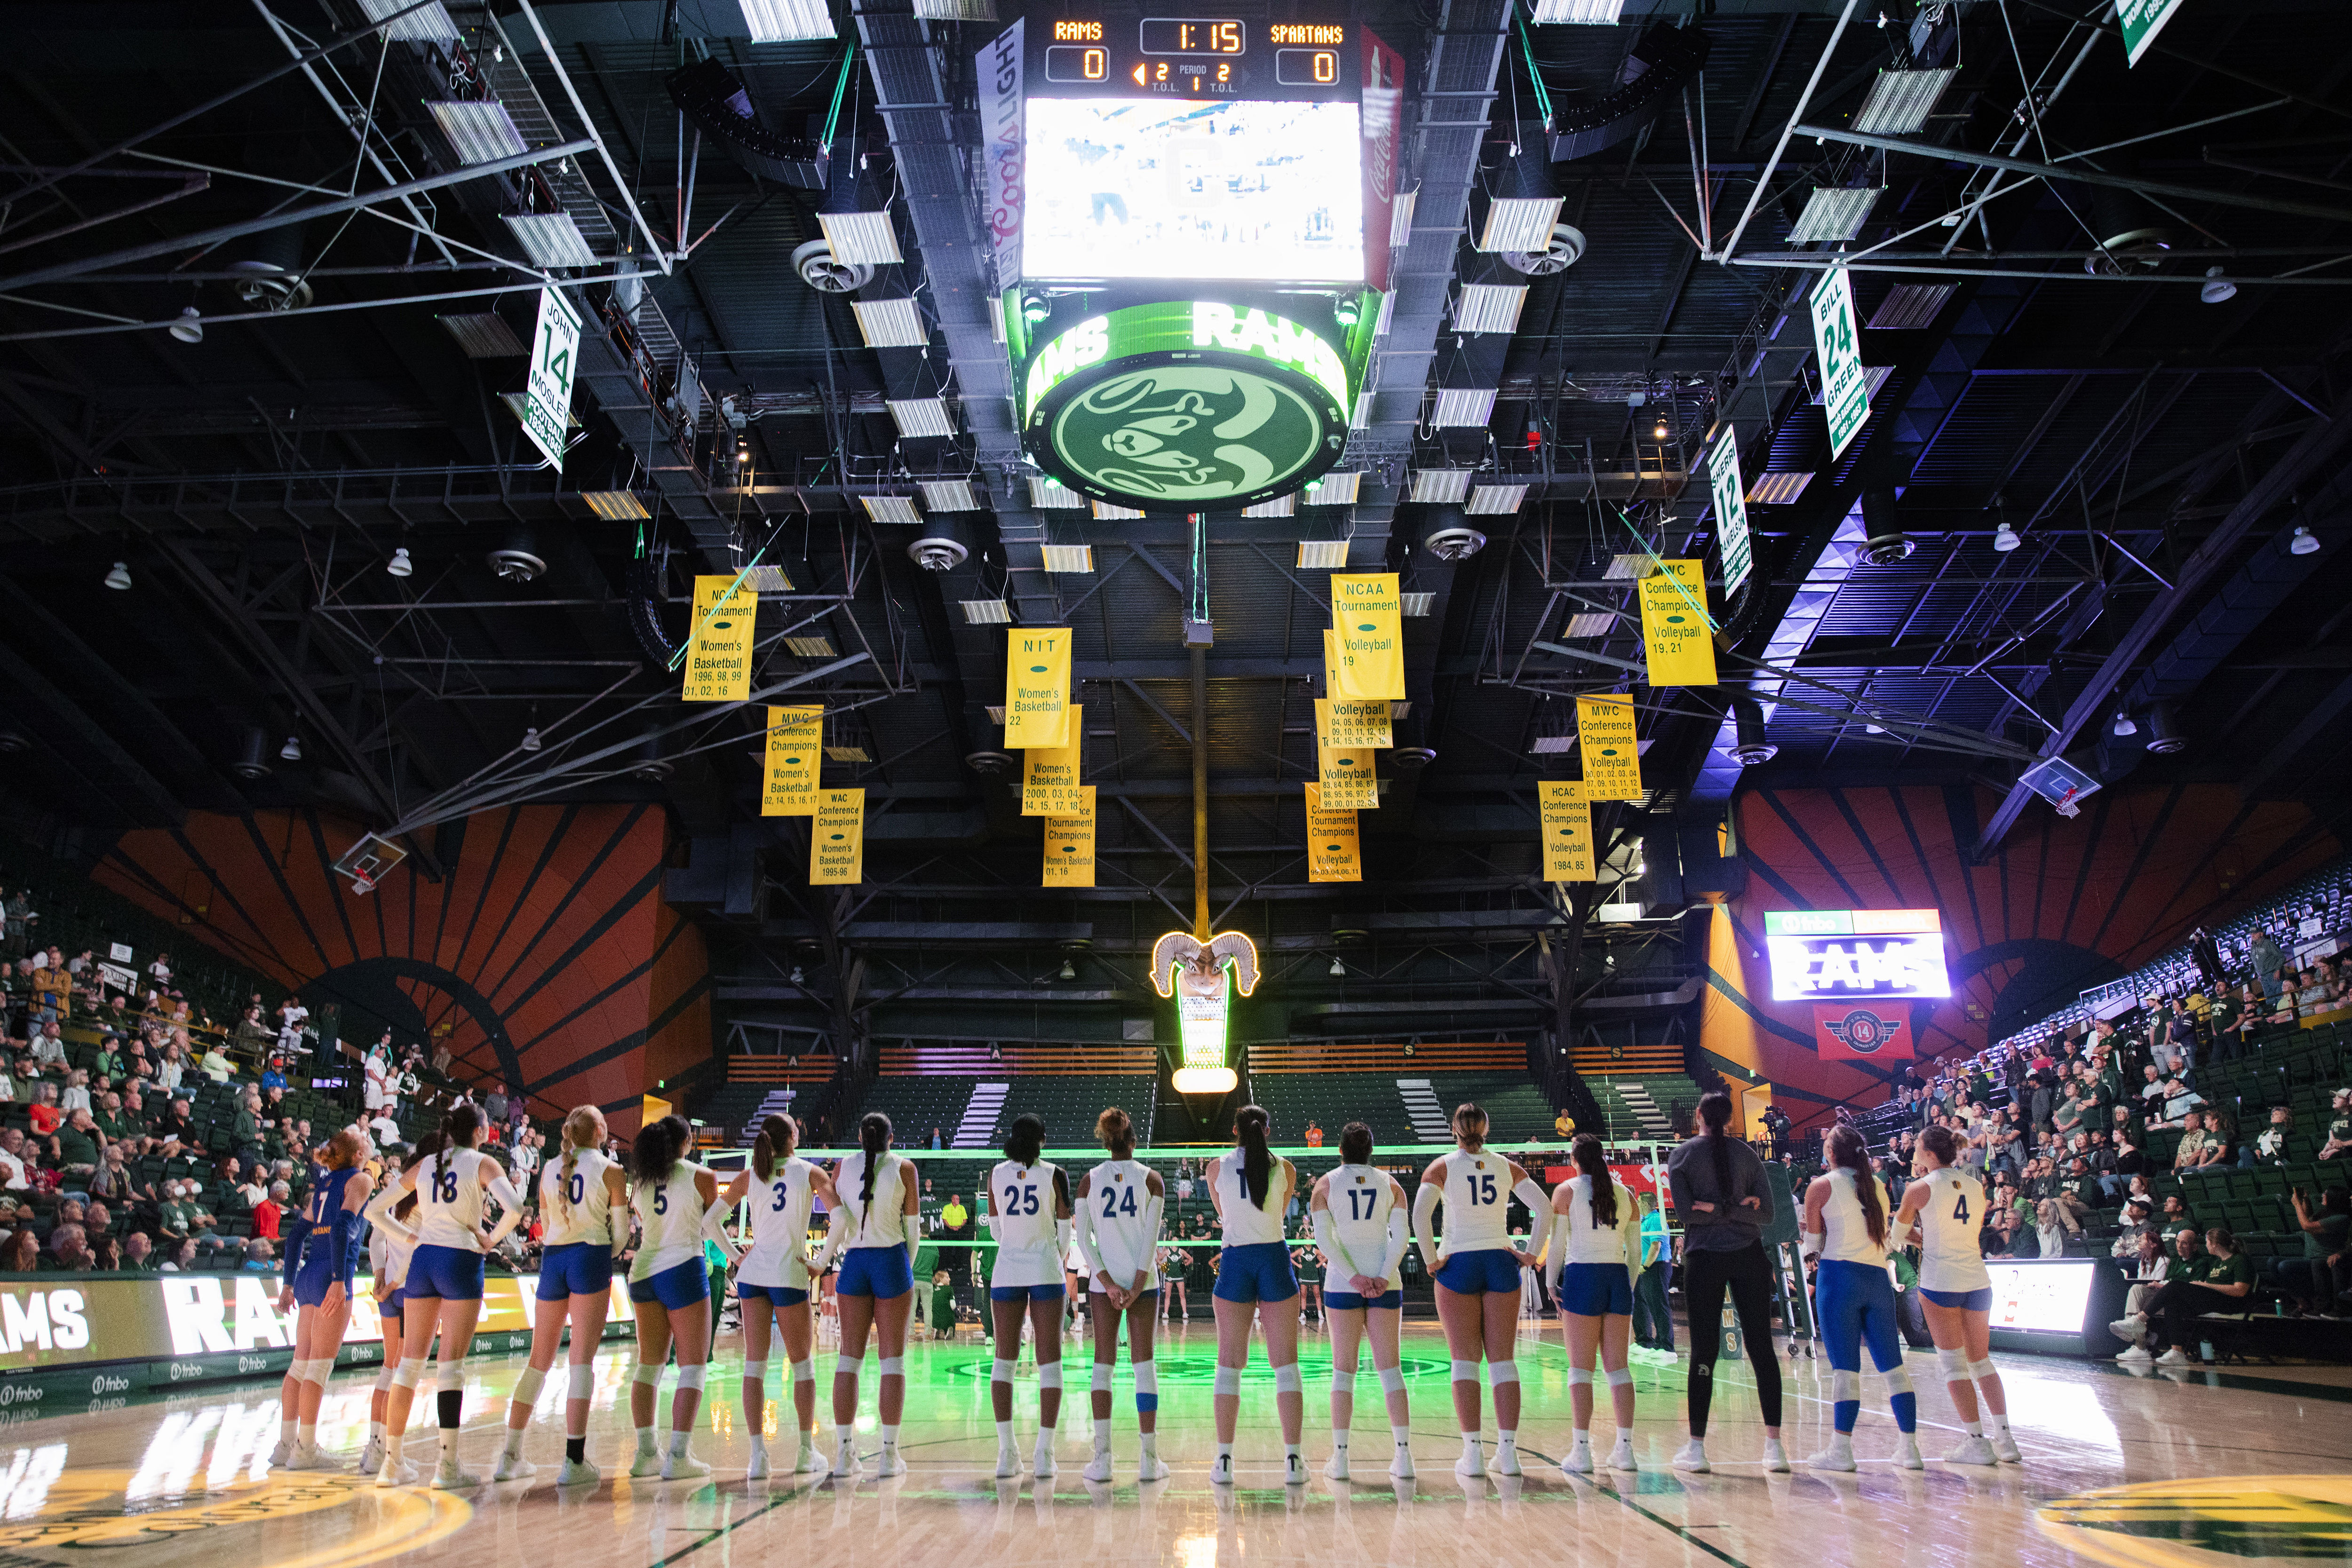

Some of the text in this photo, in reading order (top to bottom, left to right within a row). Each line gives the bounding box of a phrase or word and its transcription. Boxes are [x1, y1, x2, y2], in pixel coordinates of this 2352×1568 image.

[1056, 22, 1102, 40] RAMS
[1181, 23, 1239, 51] 1:15
[1271, 24, 1343, 44] SPARTANS
[1084, 49, 1103, 78] 0
[1180, 65, 1207, 74] PERIOD
[1315, 53, 1333, 81] 0
[995, 27, 1017, 126] LIGHT
[1156, 63, 1168, 81] 2
[1217, 63, 1230, 81] 2
[1152, 82, 1179, 92] T.O.L.
[1194, 76, 1199, 91] 1
[1210, 83, 1237, 93] T.O.L.
[992, 121, 1020, 247] Coors
[1821, 283, 1842, 323] BILL
[548, 303, 573, 344] JOHN
[1824, 301, 1852, 381] 24
[1193, 301, 1346, 400] RAMS
[544, 321, 570, 397] 14
[1027, 316, 1108, 405] AMS
[1828, 352, 1862, 408] GREEN
[532, 369, 568, 424] MOSLEY
[1841, 381, 1866, 418] BASKETBALL
[528, 396, 564, 447] FOOTBALL
[529, 412, 562, 458] 1939-1943
[1838, 420, 1849, 439] 1961
[1712, 443, 1735, 489] SHERRI
[1718, 472, 1738, 530] 12
[1720, 512, 1745, 554] DANIELSON
[1346, 584, 1384, 595] NCAA
[1646, 582, 1698, 594] Conference
[698, 606, 752, 617] Tournament
[1335, 600, 1398, 611] Tournament
[1647, 600, 1701, 613] Champions
[1654, 626, 1700, 640] Volleyball
[701, 640, 741, 651] Women's
[1345, 638, 1391, 653] Volleyball
[1653, 643, 1681, 655] 19, 21
[694, 658, 741, 669] Basketball
[1343, 656, 1354, 666] 19
[694, 671, 741, 682] 1996, 98, 99
[684, 686, 727, 697] 01, 02, 16
[1018, 688, 1058, 698] Women's
[1015, 701, 1061, 712] Basketball
[1334, 704, 1384, 717] Volleyball
[1592, 706, 1619, 716] MWC
[1010, 716, 1020, 725] 22
[1581, 721, 1632, 730] Conference
[773, 726, 817, 737] Conference
[771, 741, 817, 752] Champions
[1584, 735, 1632, 746] Champions
[1034, 763, 1071, 774] Women's
[1590, 757, 1630, 771] Volleyball
[773, 768, 809, 779] Women's
[1325, 768, 1371, 780] Volleyball
[1031, 775, 1073, 786] Basketball
[771, 782, 812, 793] Basketball
[1552, 787, 1574, 797] HCAC
[831, 794, 847, 803] WAC
[1026, 789, 1049, 799] 2000,
[1052, 789, 1065, 799] 03,
[818, 807, 858, 815] Conference
[1070, 801, 1078, 810] 18
[1543, 801, 1587, 810] Conference
[819, 818, 858, 828] Champions
[1048, 818, 1092, 827] Tournament
[1310, 816, 1355, 825] Tournament
[1544, 814, 1588, 824] Champions
[1049, 830, 1090, 842] Champions
[1312, 827, 1354, 838] Champions
[821, 844, 851, 853] Women's
[1550, 842, 1585, 854] Volleyball
[819, 856, 854, 865] Basketball
[1046, 856, 1092, 865] Women's Basketball
[1317, 855, 1352, 866] Volleyball
[1553, 860, 1584, 871] 1984, 85
[823, 867, 847, 876] 1995-96
[1857, 1025, 1870, 1038] 14
[1467, 1174, 1497, 1205] 15
[654, 1185, 668, 1216] 5
[772, 1181, 787, 1212] 3
[1004, 1184, 1040, 1216] 25
[1101, 1186, 1137, 1218] 24
[1347, 1188, 1377, 1221] 17
[1953, 1194, 1970, 1225] 4
[359, 1347, 373, 1359] fnbo
[248, 1356, 267, 1370] fnbo
[181, 1363, 203, 1377] fnbo
[104, 1375, 129, 1392] fnbo
[16, 1385, 43, 1403] fnbo
